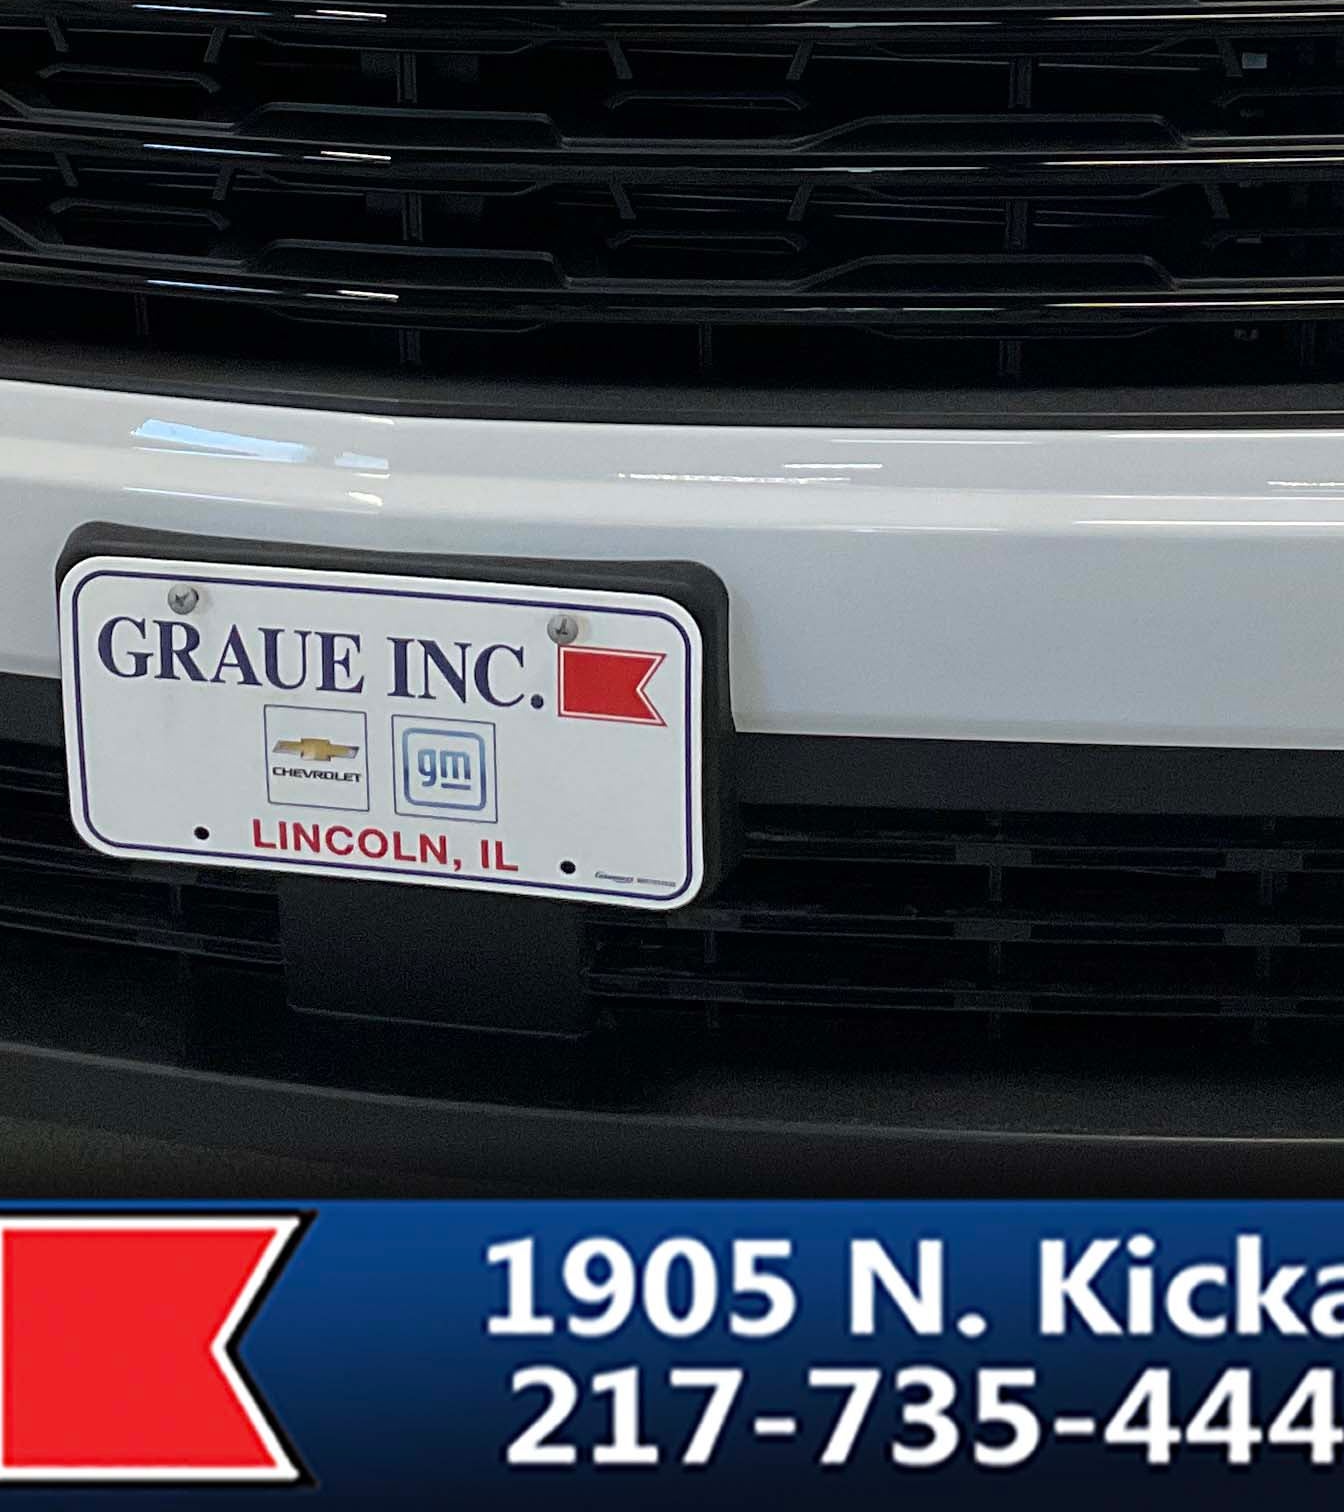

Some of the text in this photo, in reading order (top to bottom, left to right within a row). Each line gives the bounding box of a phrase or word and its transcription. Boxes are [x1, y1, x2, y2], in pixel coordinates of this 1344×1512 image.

[97, 615, 546, 711] GRAUE INC.
[271, 765, 363, 784] CHEVROLET
[417, 748, 472, 790] gm
[252, 818, 519, 872] LINCOLN, IL
